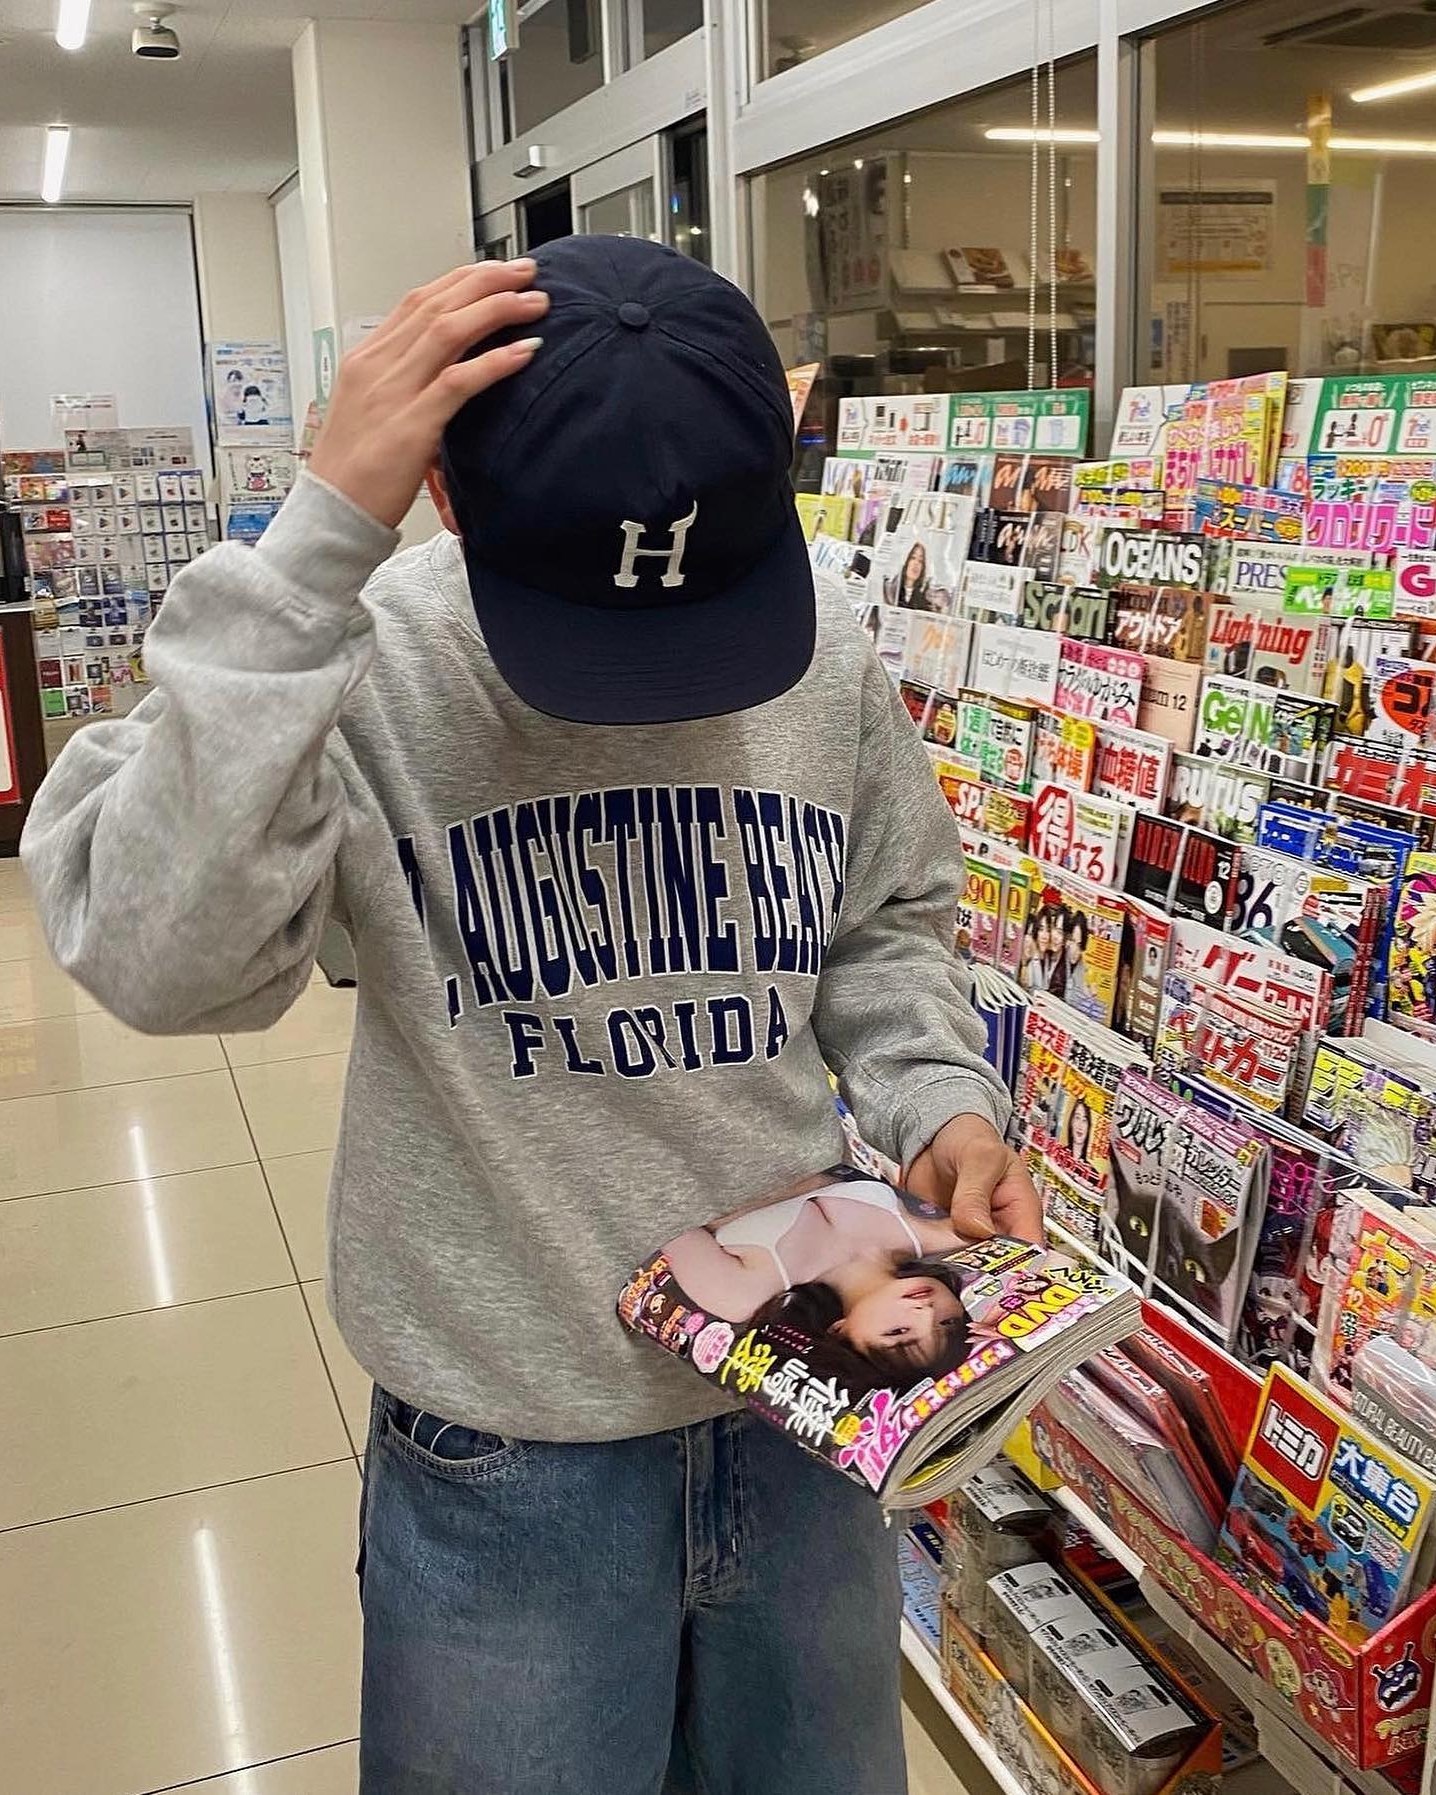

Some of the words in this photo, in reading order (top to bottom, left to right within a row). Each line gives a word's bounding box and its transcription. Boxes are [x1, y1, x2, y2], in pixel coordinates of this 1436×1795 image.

[613, 500, 698, 588] H
[1104, 531, 1202, 585] OCEANS
[446, 784, 742, 1009] AUGUSTINE
[501, 984, 791, 1079] FLORIDA
[998, 1283, 1081, 1339] DVD
[1260, 1400, 1327, 1480] トミカ
[1334, 1438, 1420, 1523] 大集合
